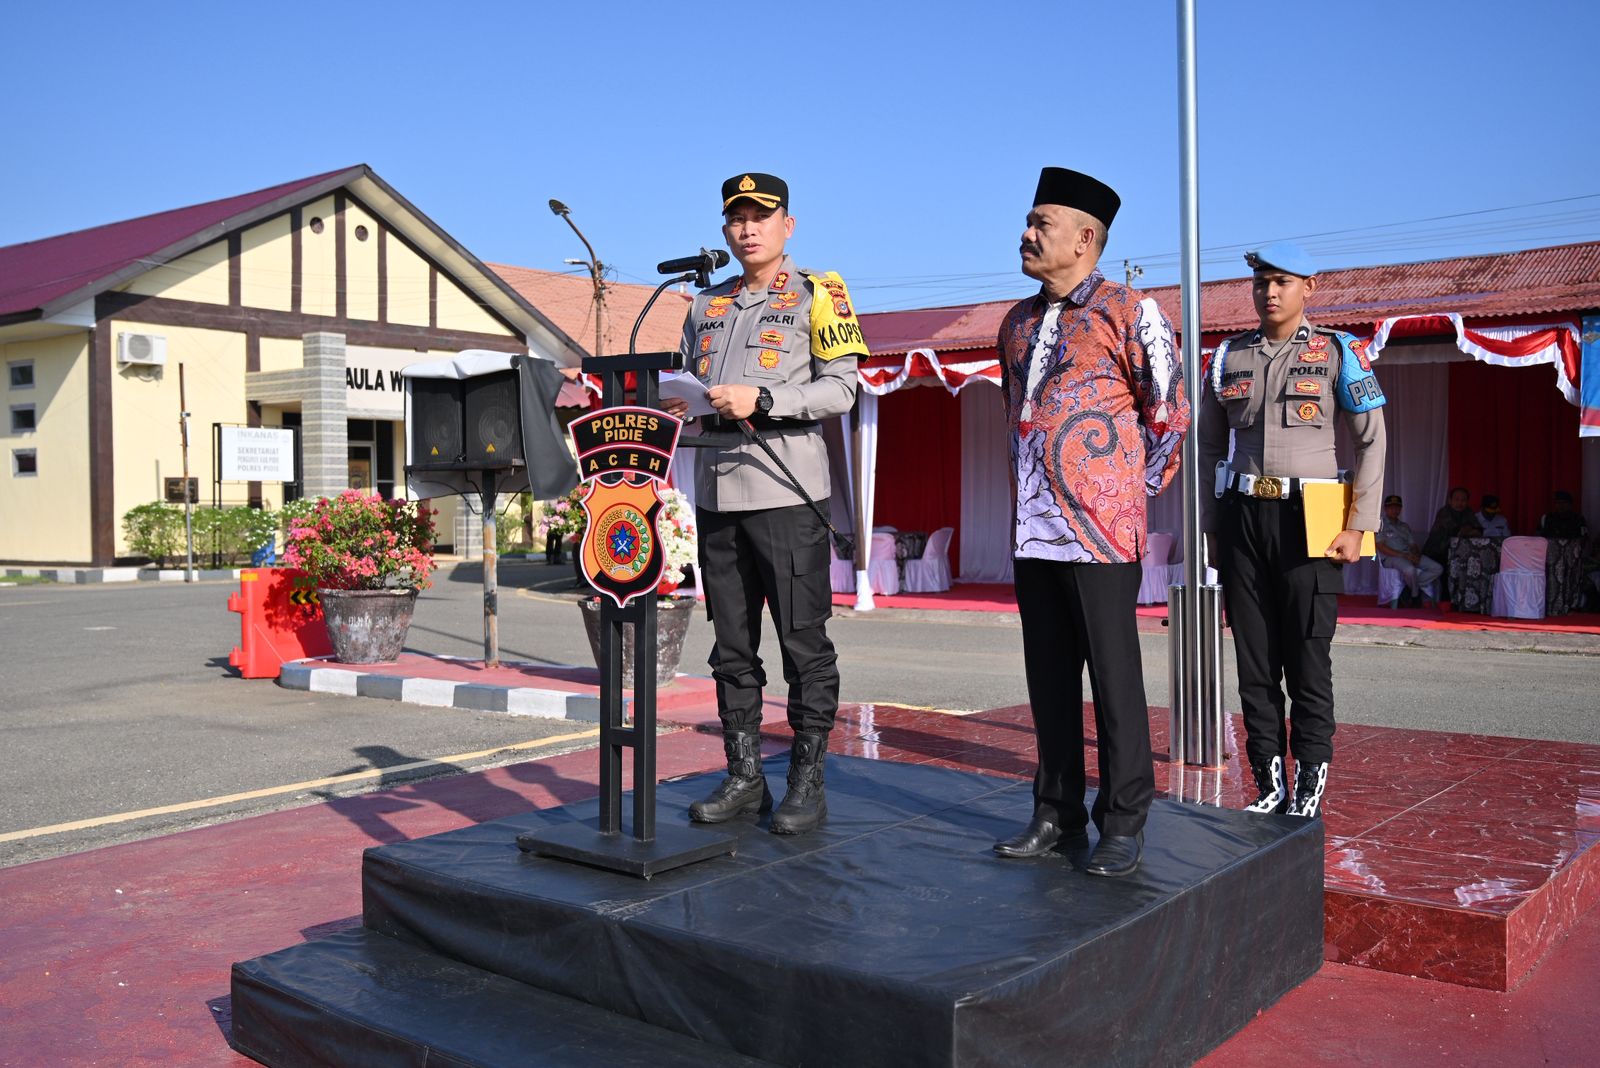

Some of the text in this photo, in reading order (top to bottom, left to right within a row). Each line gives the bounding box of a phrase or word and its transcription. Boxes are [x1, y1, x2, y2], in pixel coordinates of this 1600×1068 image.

[697, 320, 724, 332] JAKA
[758, 315, 794, 326] POLRI
[838, 322, 865, 344] OPS
[1287, 366, 1329, 376] POLRI
[346, 367, 385, 391] AULA
[1347, 375, 1382, 407] PR
[591, 414, 659, 434] POLRES
[237, 430, 279, 440] INKANAS
[604, 428, 644, 442] PIDIE
[237, 446, 279, 455] SEKRETARIAT
[237, 464, 279, 473] POLRES PIDIE
[589, 453, 660, 472] ACEH
